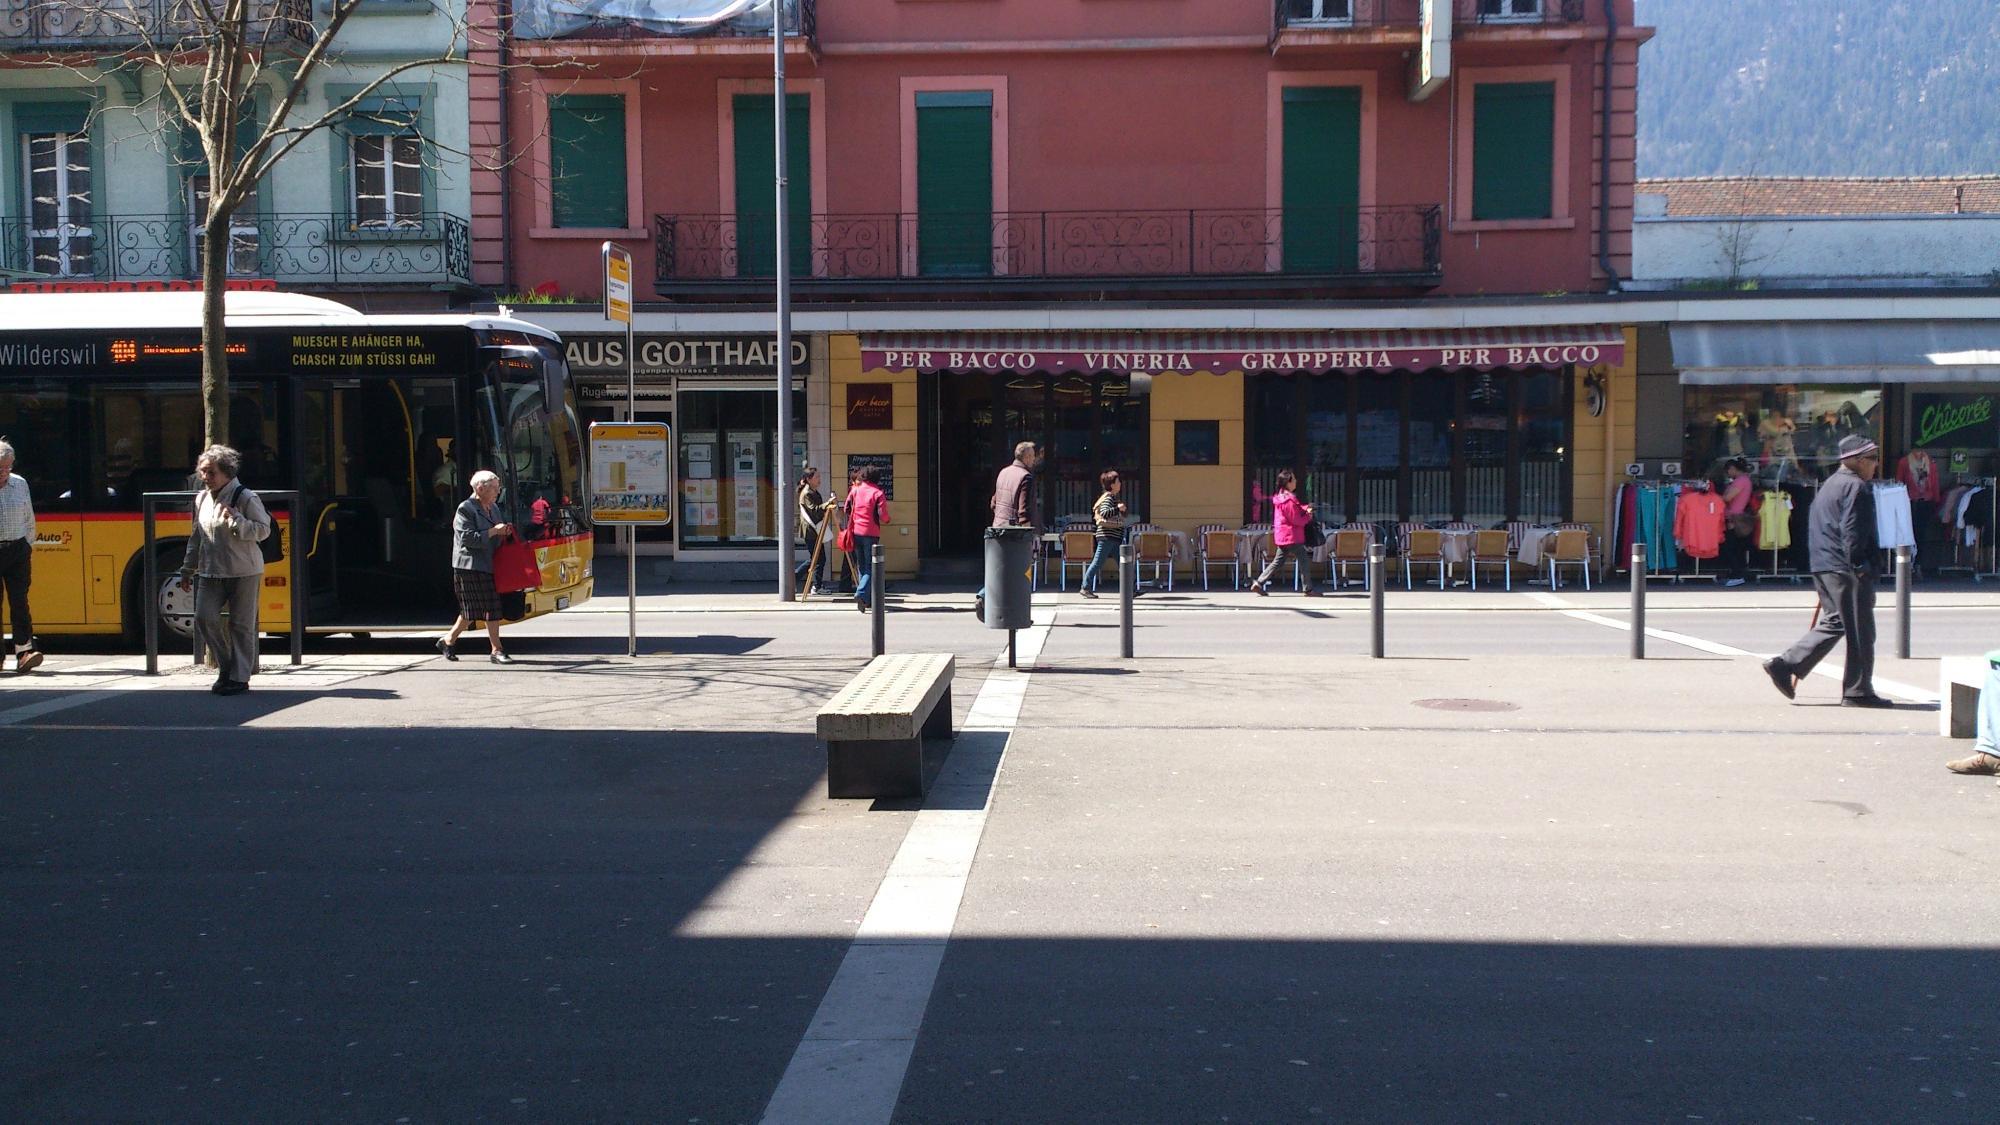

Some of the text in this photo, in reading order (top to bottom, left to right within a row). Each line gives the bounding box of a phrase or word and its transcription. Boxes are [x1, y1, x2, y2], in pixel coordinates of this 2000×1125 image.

[293, 334, 425, 348] MUESCH E AHÄNGER HA,
[0, 344, 96, 365] Wilderswil
[292, 351, 436, 366] CHASCH ZUM STÜSSI GAH!
[884, 351, 932, 367] PER
[949, 352, 1036, 369] BACCO
[1084, 353, 1193, 370] VINERIA
[1241, 352, 1392, 370] GRAPPERIA
[1440, 350, 1491, 366] PER
[1507, 346, 1600, 364] BACCO
